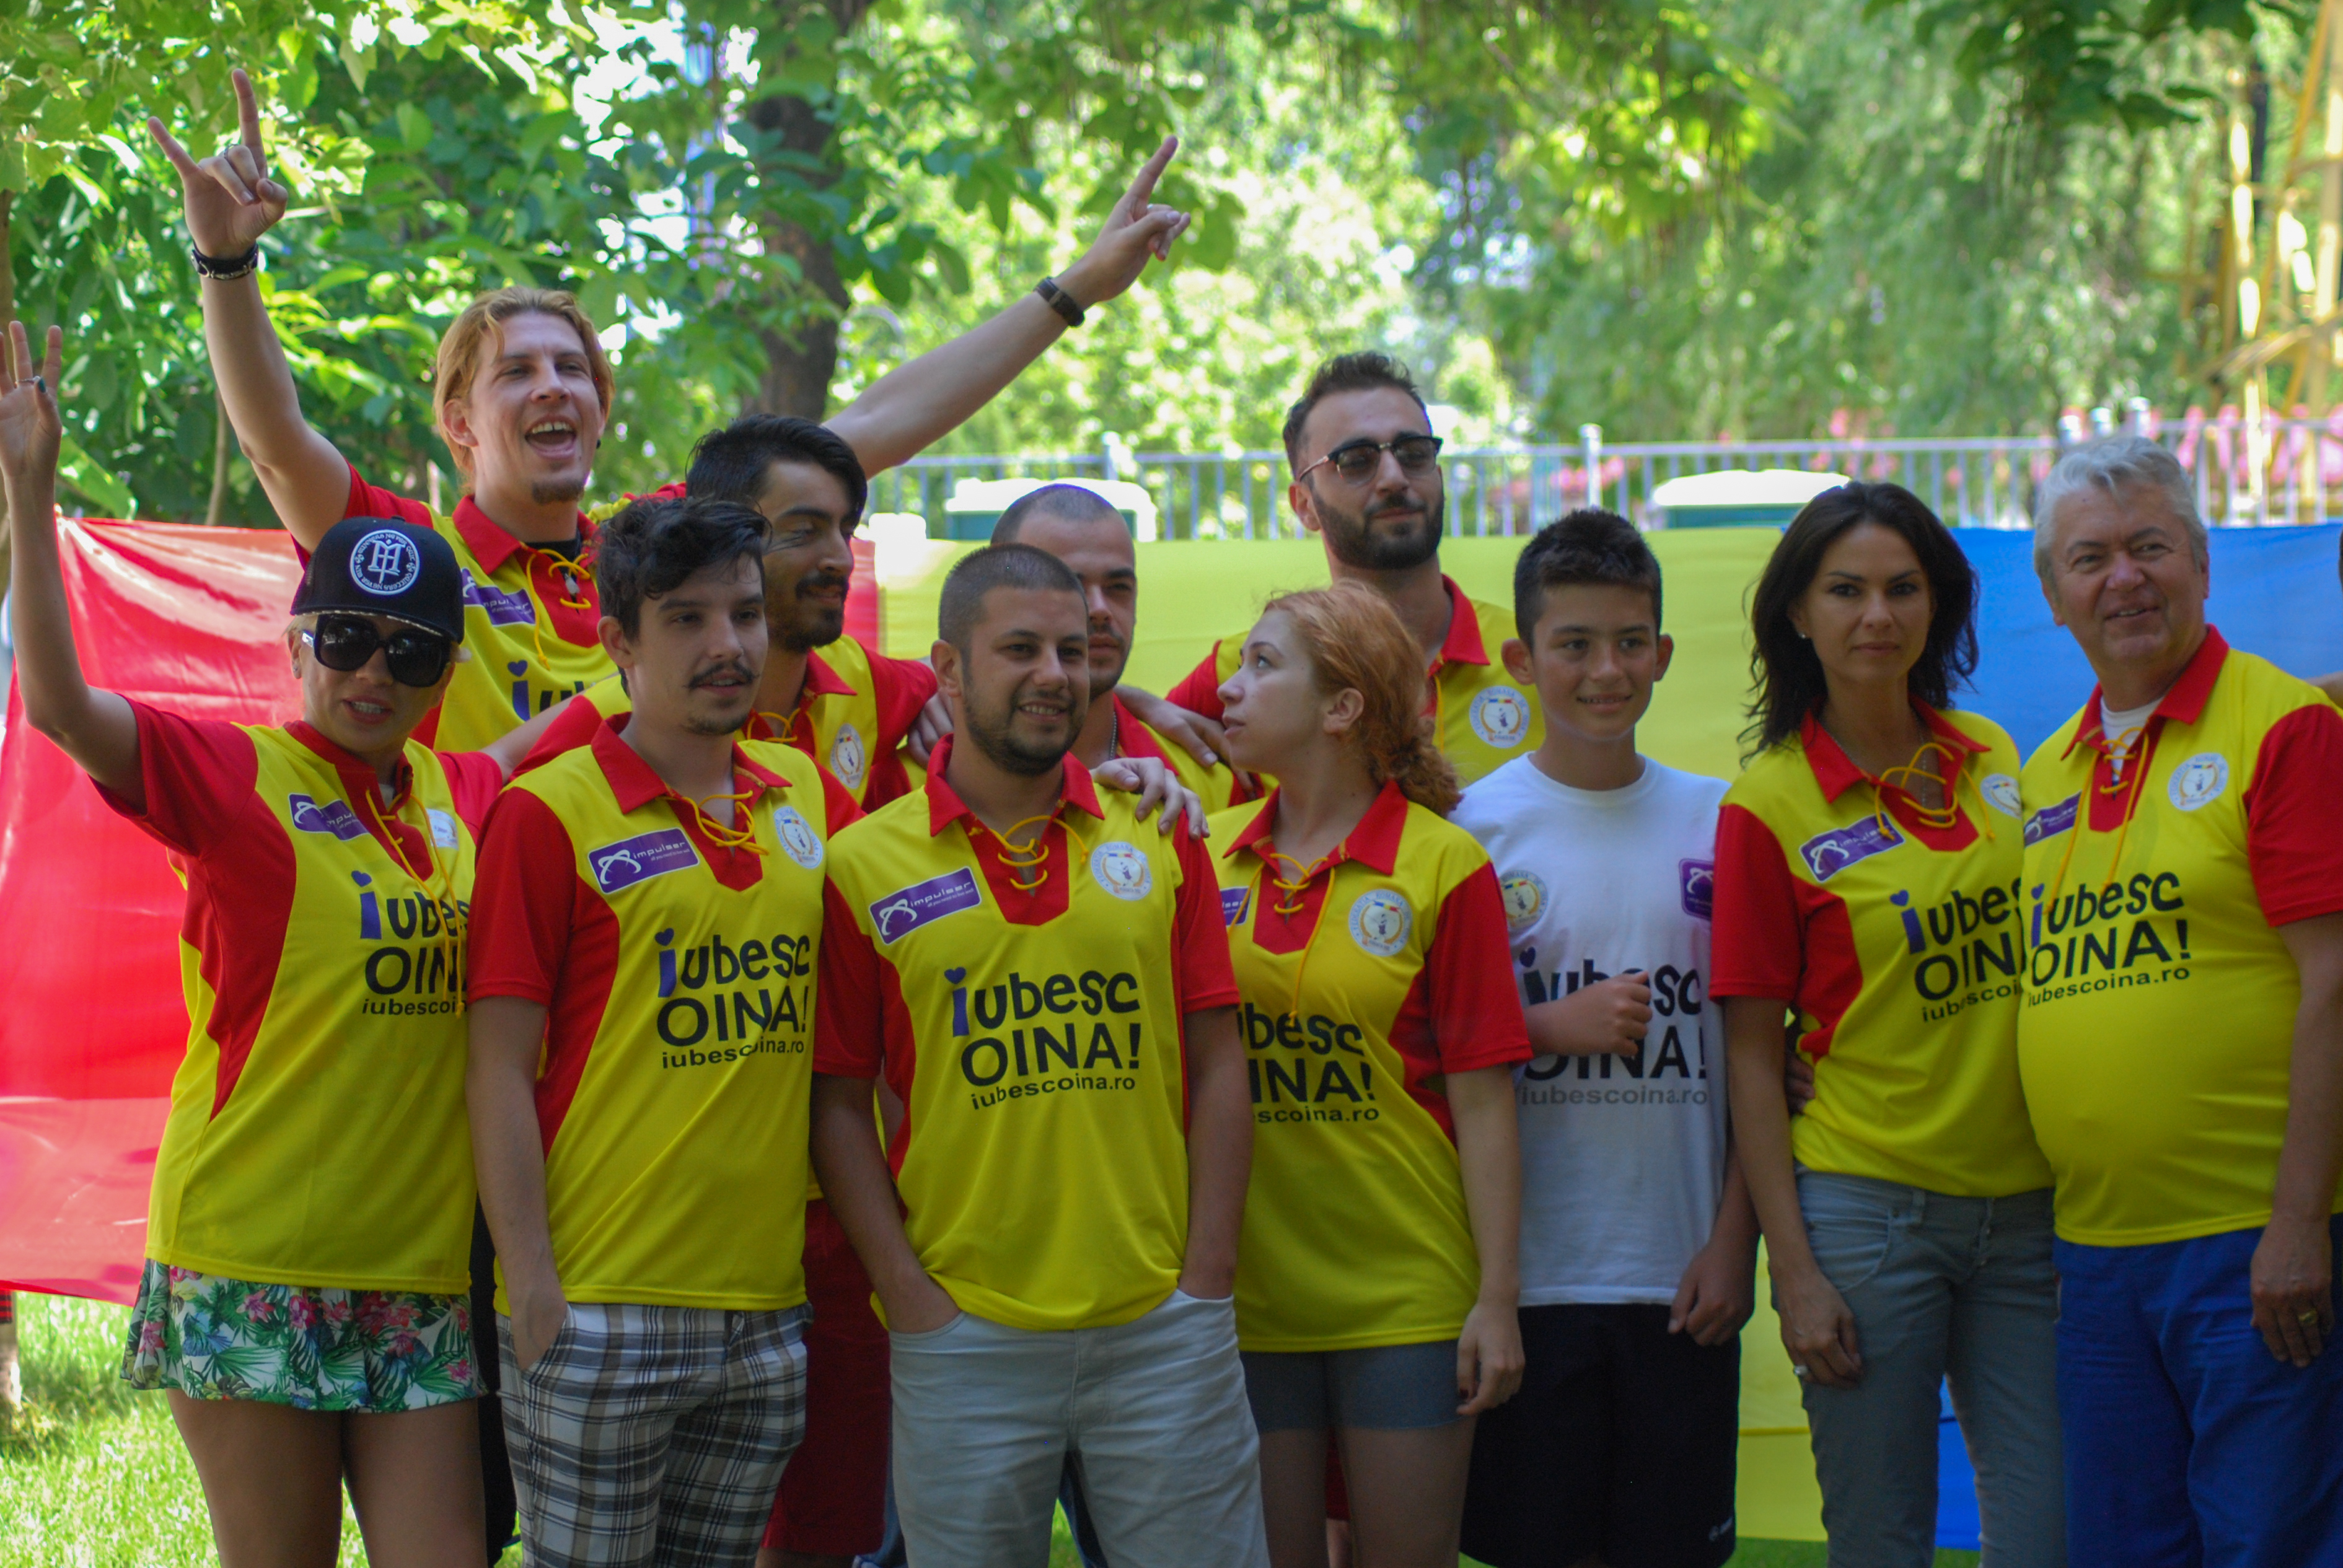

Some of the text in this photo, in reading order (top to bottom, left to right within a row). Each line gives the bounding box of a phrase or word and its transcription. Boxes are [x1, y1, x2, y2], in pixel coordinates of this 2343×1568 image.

[351, 870, 470, 940] iube
[1889, 877, 2022, 955] iube
[364, 945, 467, 995] OIN
[654, 927, 810, 998] iubesc
[1914, 932, 2026, 1001] OIN
[2031, 919, 2191, 987] OINA!
[657, 986, 809, 1047] OINA!
[944, 966, 1140, 1037] iubesc
[2028, 968, 2190, 1007] iubescoina.ro
[960, 1023, 1141, 1087] OINA!
[1237, 1002, 1366, 1057] besc
[971, 1073, 1135, 1110] iubescoina.ro
[1247, 1058, 1375, 1103] INA!
[1522, 1085, 1707, 1106] iubescoina.ro
[1253, 1105, 1379, 1124] scoina.ro
